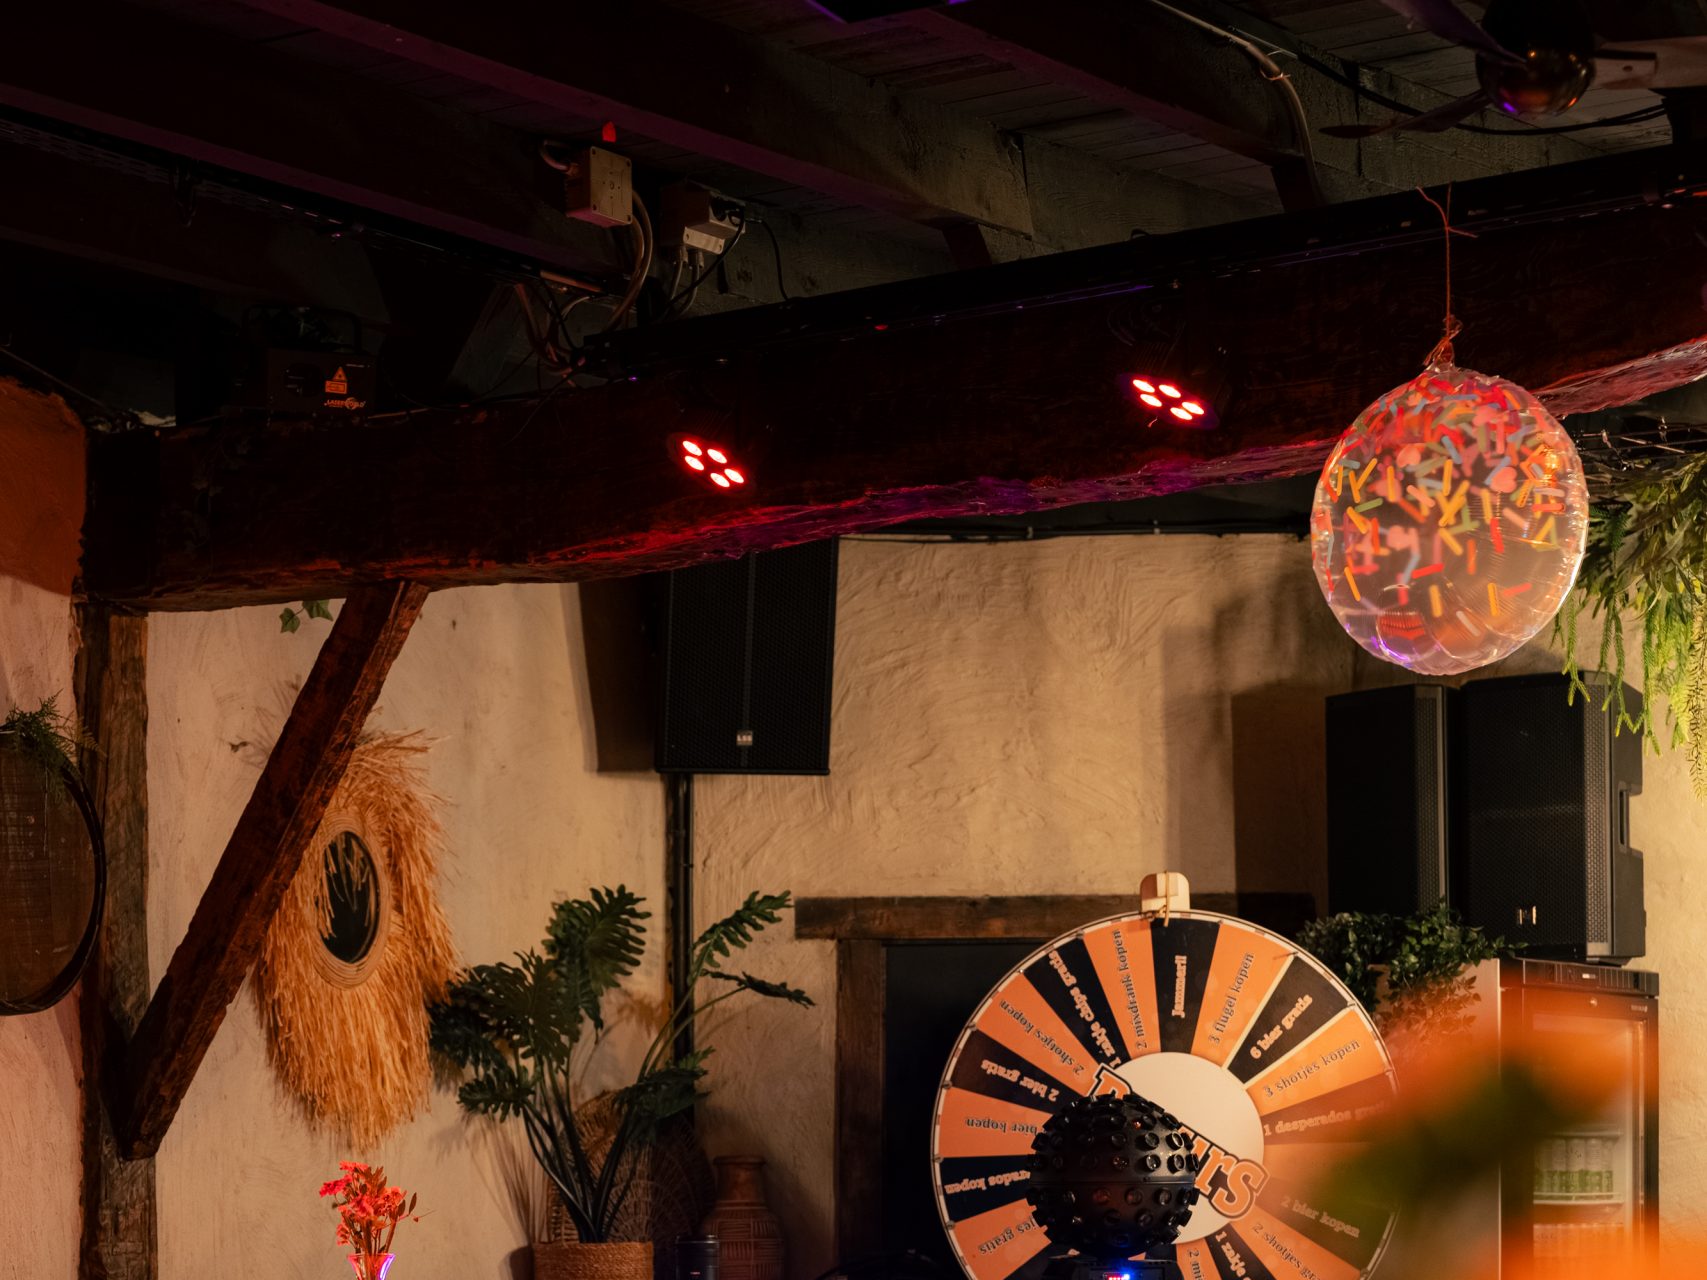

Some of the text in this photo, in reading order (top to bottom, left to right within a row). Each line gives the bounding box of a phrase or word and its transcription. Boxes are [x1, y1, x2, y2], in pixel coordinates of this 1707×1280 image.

[1049, 950, 1121, 1068] 1 zakje chips gratis
[1113, 930, 1147, 1049] 2 mixdrank kopen
[1209, 1035, 1220, 1045] 3
[1230, 953, 1254, 993] kopen
[1000, 1000, 1085, 1076] 2 shotjes kopen
[1250, 994, 1313, 1059] 6 bier gratis
[981, 1059, 1059, 1102] 2 bier gratis
[1264, 1039, 1361, 1098] 3 shotjes kopen
[966, 1118, 1007, 1133] kopen
[1011, 1124, 1038, 1136] bier
[1263, 1123, 1272, 1136] 1
[1275, 1110, 1351, 1134] desperados
[944, 1178, 987, 1194] kopen
[979, 1228, 1015, 1254] gratis
[1293, 1200, 1319, 1220] bier
[1320, 1212, 1361, 1238] kopen
[1188, 1250, 1199, 1258] 2
[1215, 1231, 1227, 1242] 1
[1221, 1242, 1246, 1277] zakje
[1252, 1223, 1264, 1234] 2
[1264, 1233, 1301, 1269] shotjes
